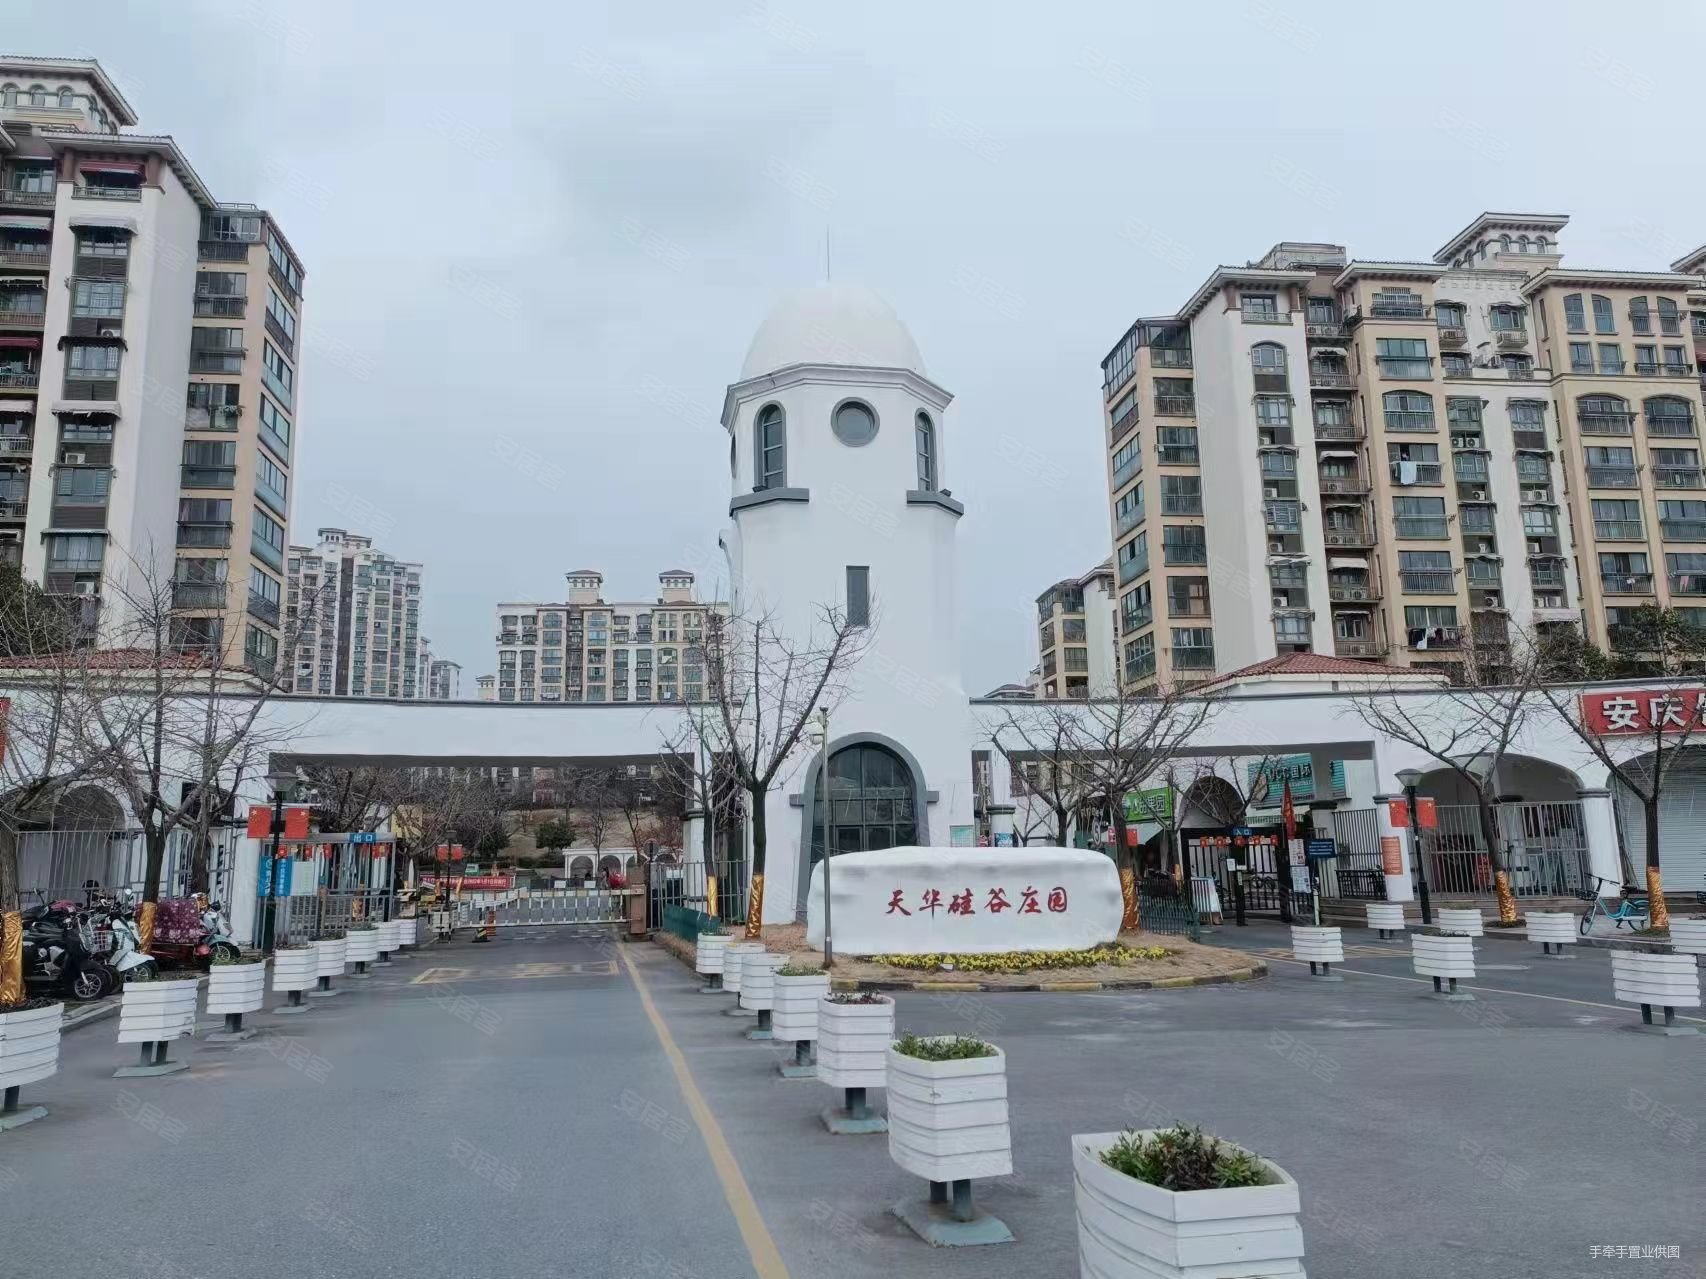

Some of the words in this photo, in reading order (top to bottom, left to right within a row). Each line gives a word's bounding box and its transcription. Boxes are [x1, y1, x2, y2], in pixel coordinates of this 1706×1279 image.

[1603, 693, 1706, 730] 安庆
[353, 834, 373, 843] 出口
[886, 886, 1068, 919] 天华硅谷庄园
